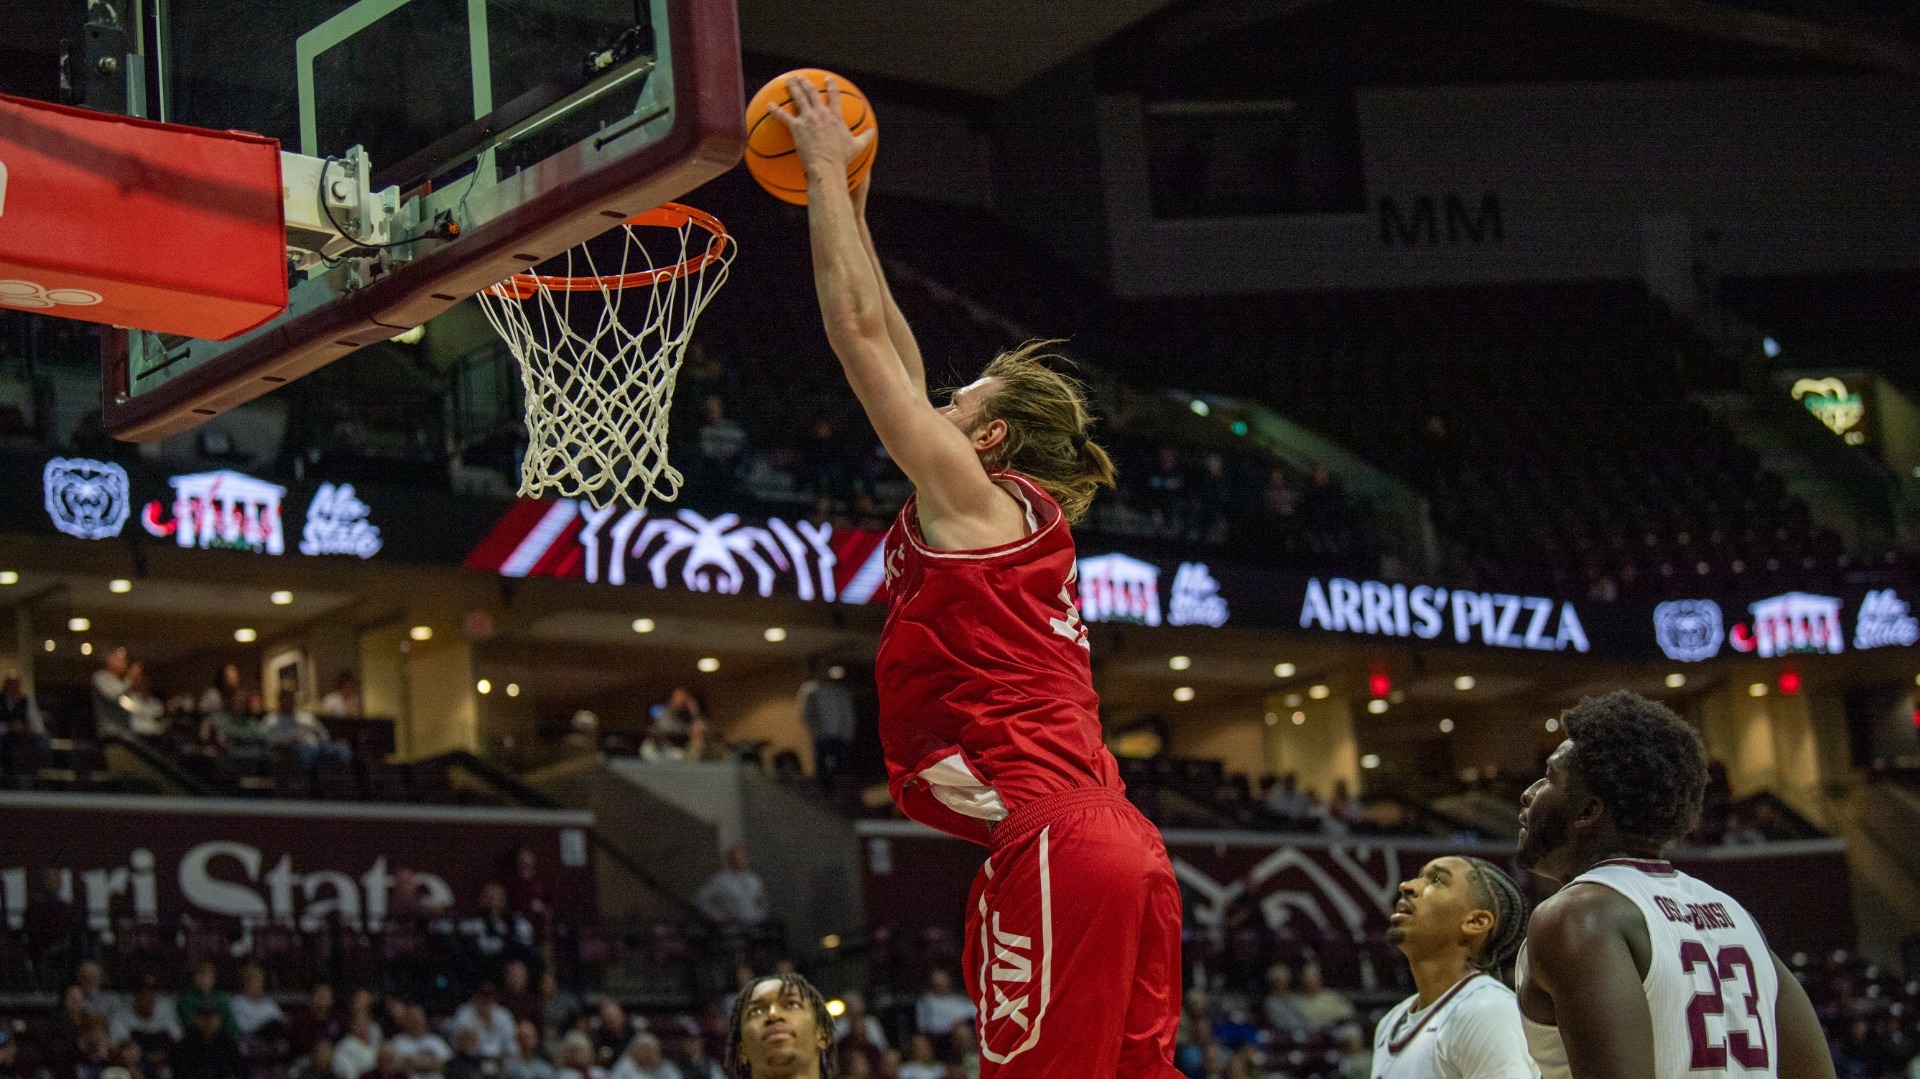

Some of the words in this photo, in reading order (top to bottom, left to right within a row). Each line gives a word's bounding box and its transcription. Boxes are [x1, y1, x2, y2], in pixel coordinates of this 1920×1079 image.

[1378, 191, 1504, 247] MM
[1451, 590, 1590, 653] PIZZA
[992, 911, 1031, 1032] JAX
[1679, 938, 1769, 1071] 23
